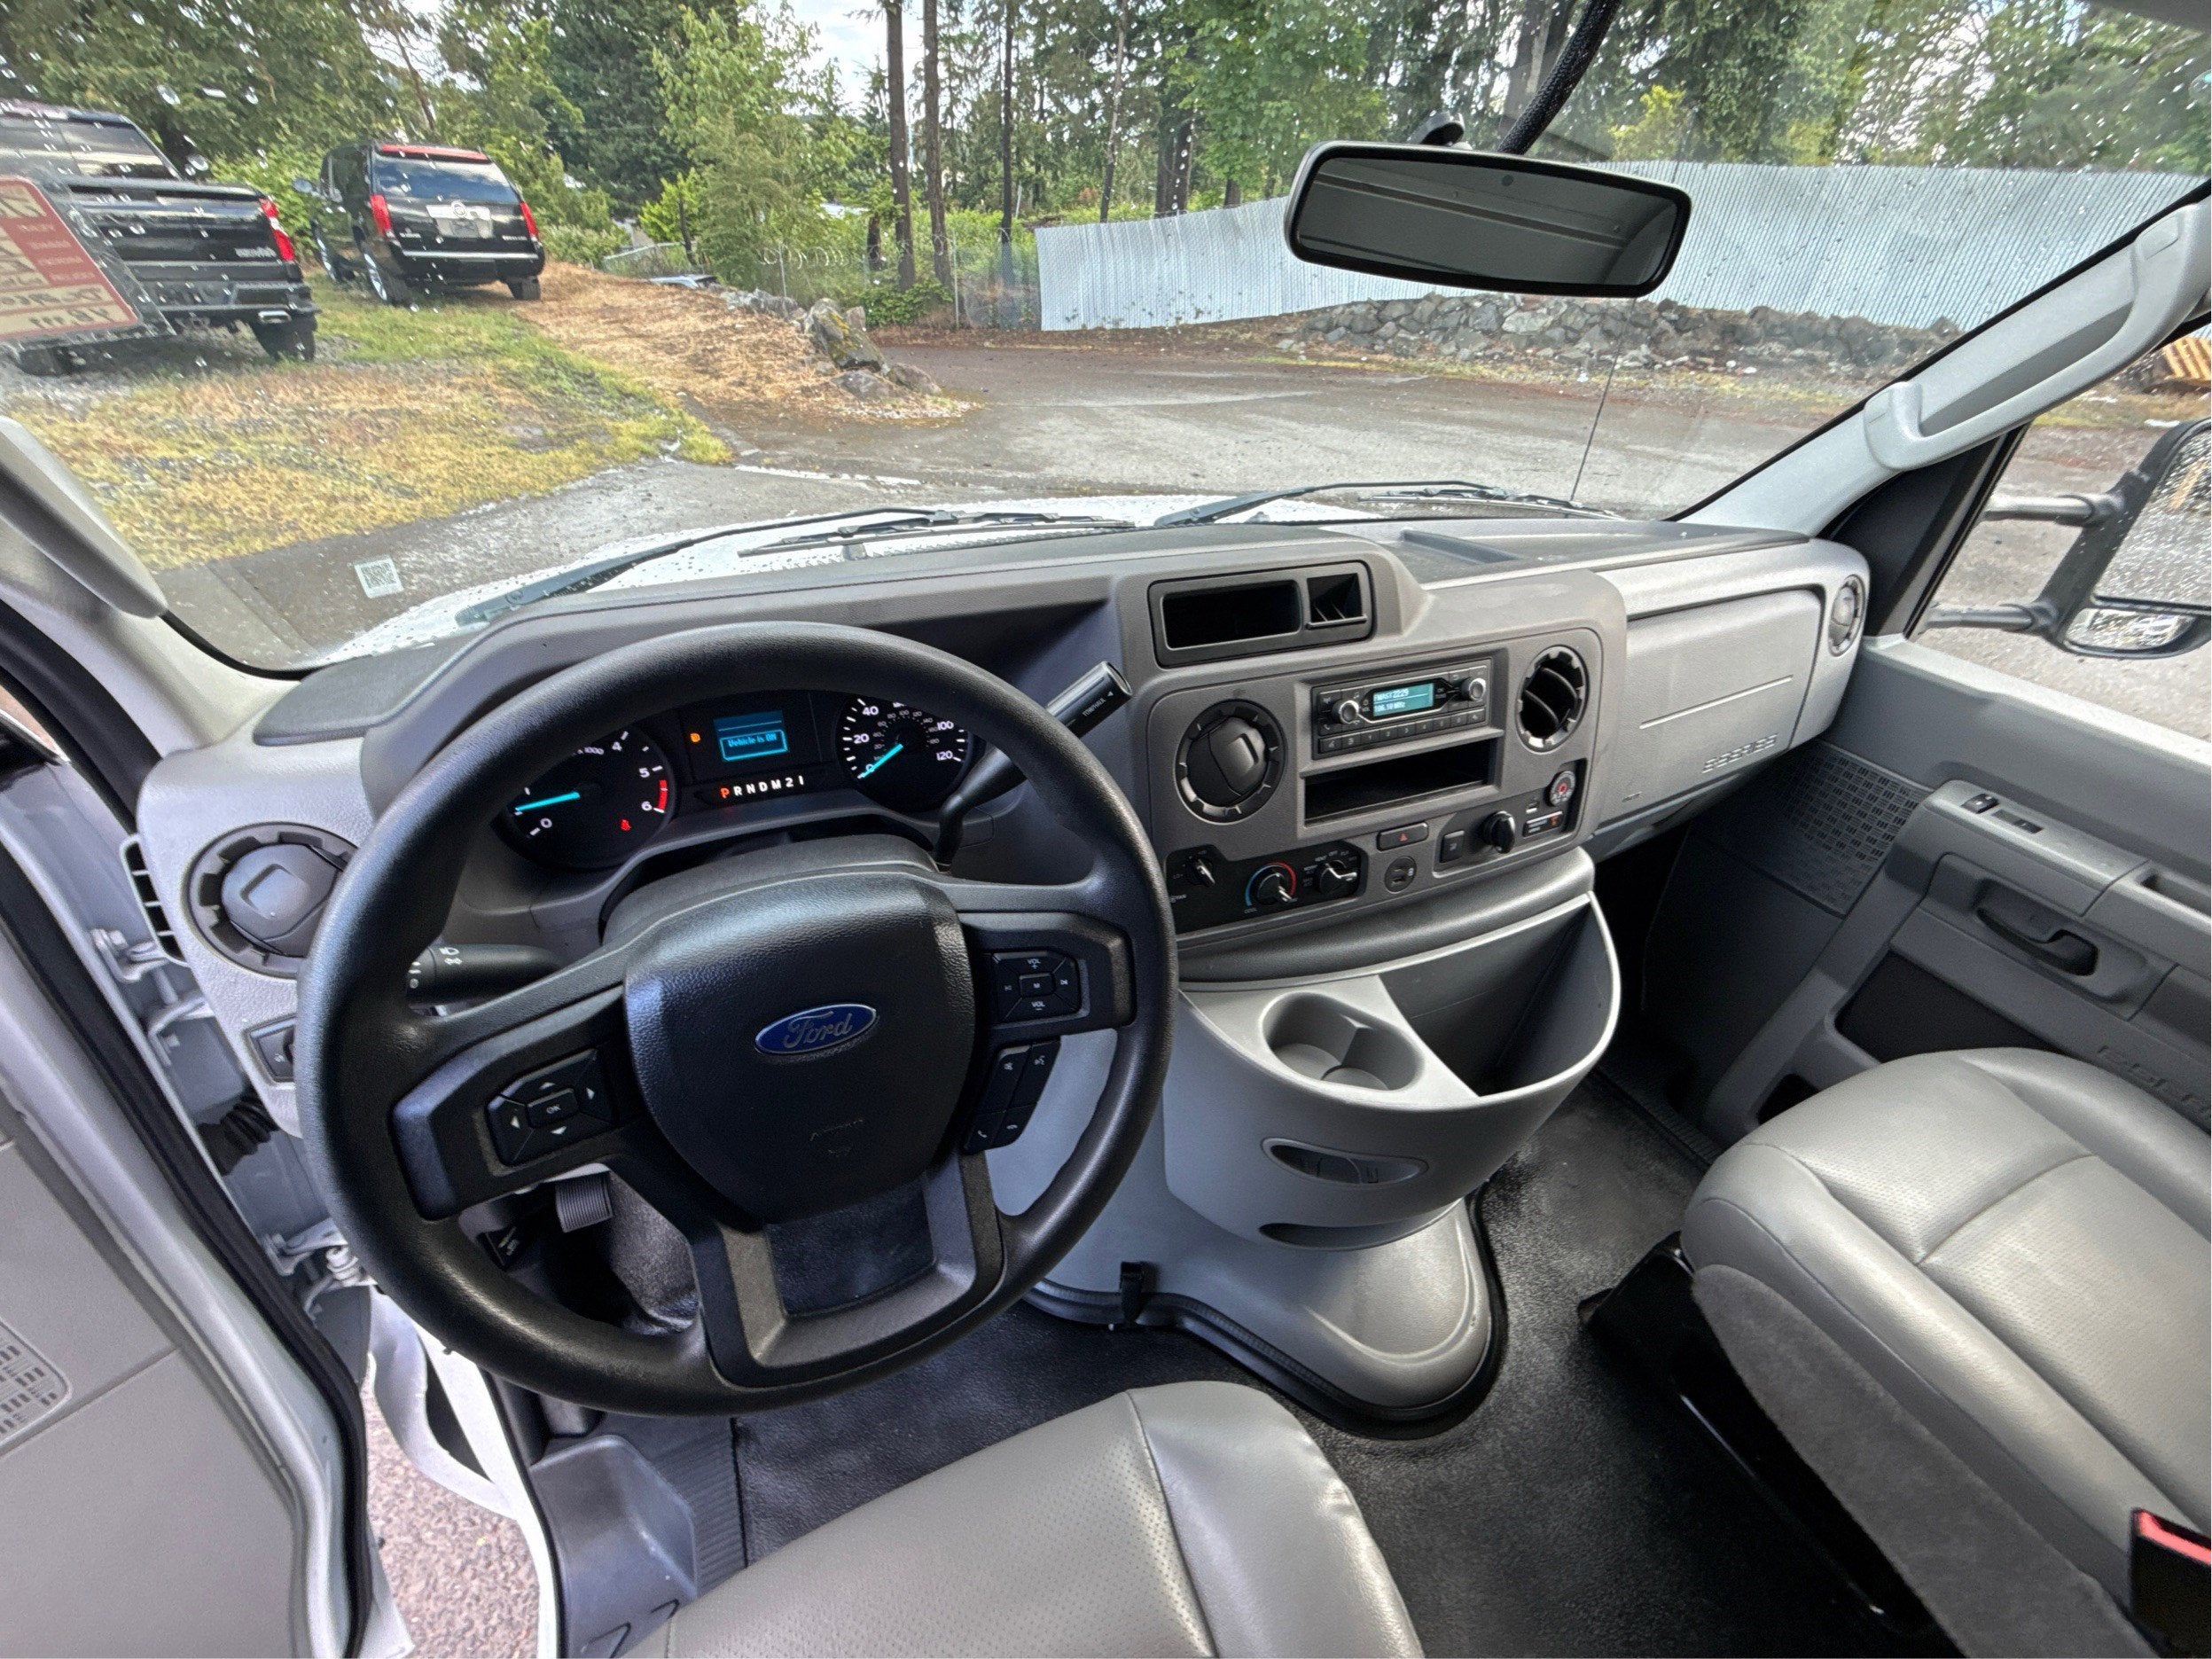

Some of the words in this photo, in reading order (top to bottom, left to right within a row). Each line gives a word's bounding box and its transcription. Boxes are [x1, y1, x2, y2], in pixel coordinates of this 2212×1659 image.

[862, 705, 879, 716] 40
[936, 720, 954, 730] 100
[853, 732, 870, 744] 20
[612, 741, 622, 752] 4
[936, 750, 953, 761] 120
[638, 767, 650, 778] 5
[721, 787, 730, 799] P
[734, 786, 743, 797] R
[746, 783, 755, 794] N
[759, 780, 768, 792] D
[771, 779, 782, 790] M
[786, 777, 794, 787] 2
[641, 800, 653, 810] 6
[540, 817, 552, 828] 0
[783, 1010, 853, 1048] Ford
